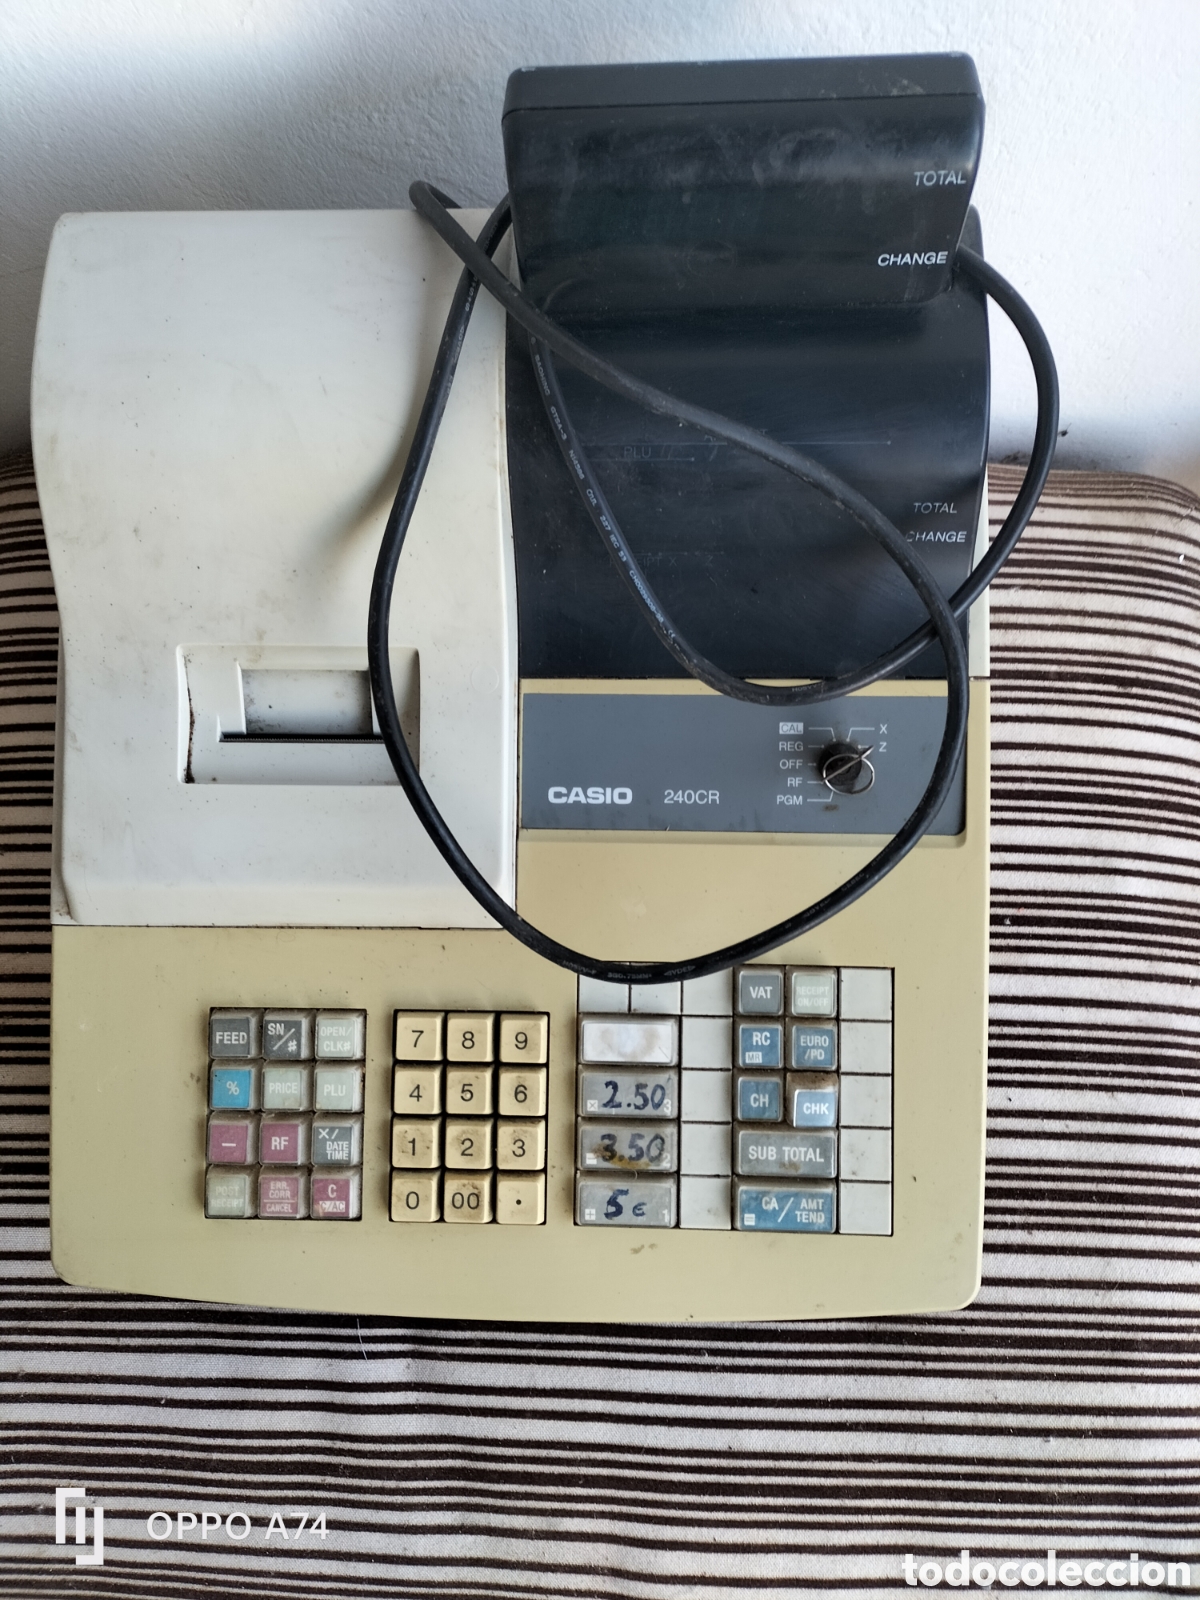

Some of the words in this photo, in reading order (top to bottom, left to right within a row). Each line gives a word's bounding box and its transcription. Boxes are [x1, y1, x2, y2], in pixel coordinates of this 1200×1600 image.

[914, 170, 966, 186] TOTAL
[877, 251, 949, 267] CHANGE
[913, 502, 958, 514] TOTAL
[906, 530, 968, 543] CHANGE
[780, 723, 803, 735] CAL
[879, 723, 888, 734] X
[779, 742, 804, 752] REG
[878, 742, 887, 752] Z
[779, 759, 803, 770] OFF
[787, 777, 803, 788] RF
[547, 786, 633, 805] CASIO
[663, 789, 720, 805] 240CR
[776, 795, 803, 806] PGM
[749, 986, 773, 999] VAT
[796, 986, 829, 996] RECEIPT
[797, 997, 829, 1007] ON/OFF
[215, 1031, 248, 1045] FEED
[320, 1026, 352, 1037] OPEN/
[411, 1029, 424, 1048] 7
[461, 1030, 475, 1050] 8
[514, 1031, 528, 1050] 9
[752, 1031, 771, 1046] RC
[800, 1035, 829, 1047] EURO
[323, 1041, 352, 1052] CLK#
[746, 1052, 762, 1063] MR
[804, 1048, 825, 1061] /PD
[226, 1080, 240, 1096] %
[269, 1081, 298, 1094] PRICE
[323, 1084, 347, 1097] PLU
[409, 1084, 423, 1102] 4
[460, 1083, 474, 1102] 5
[514, 1084, 528, 1103] 6
[601, 1080, 666, 1111] 2.50
[750, 1093, 769, 1108] CH
[803, 1102, 829, 1115] CHK
[271, 1136, 289, 1151] RF
[326, 1141, 349, 1151] DATE
[407, 1137, 416, 1156] 1
[460, 1137, 474, 1157] 2
[512, 1138, 526, 1158] 3
[600, 1133, 666, 1163] 3.50
[326, 1150, 349, 1160] TIME
[748, 1145, 777, 1161] SUB
[782, 1146, 825, 1162] TOTAL
[215, 1185, 240, 1197] POST
[269, 1189, 291, 1199] CORR
[328, 1184, 337, 1198] C
[211, 1198, 244, 1208] RECEIPT
[405, 1191, 420, 1210] 0
[451, 1191, 480, 1210] 00
[603, 1188, 630, 1221] 5
[800, 1198, 825, 1210] AMT
[266, 1203, 293, 1213] CANCEL
[795, 1211, 825, 1224] TEND
